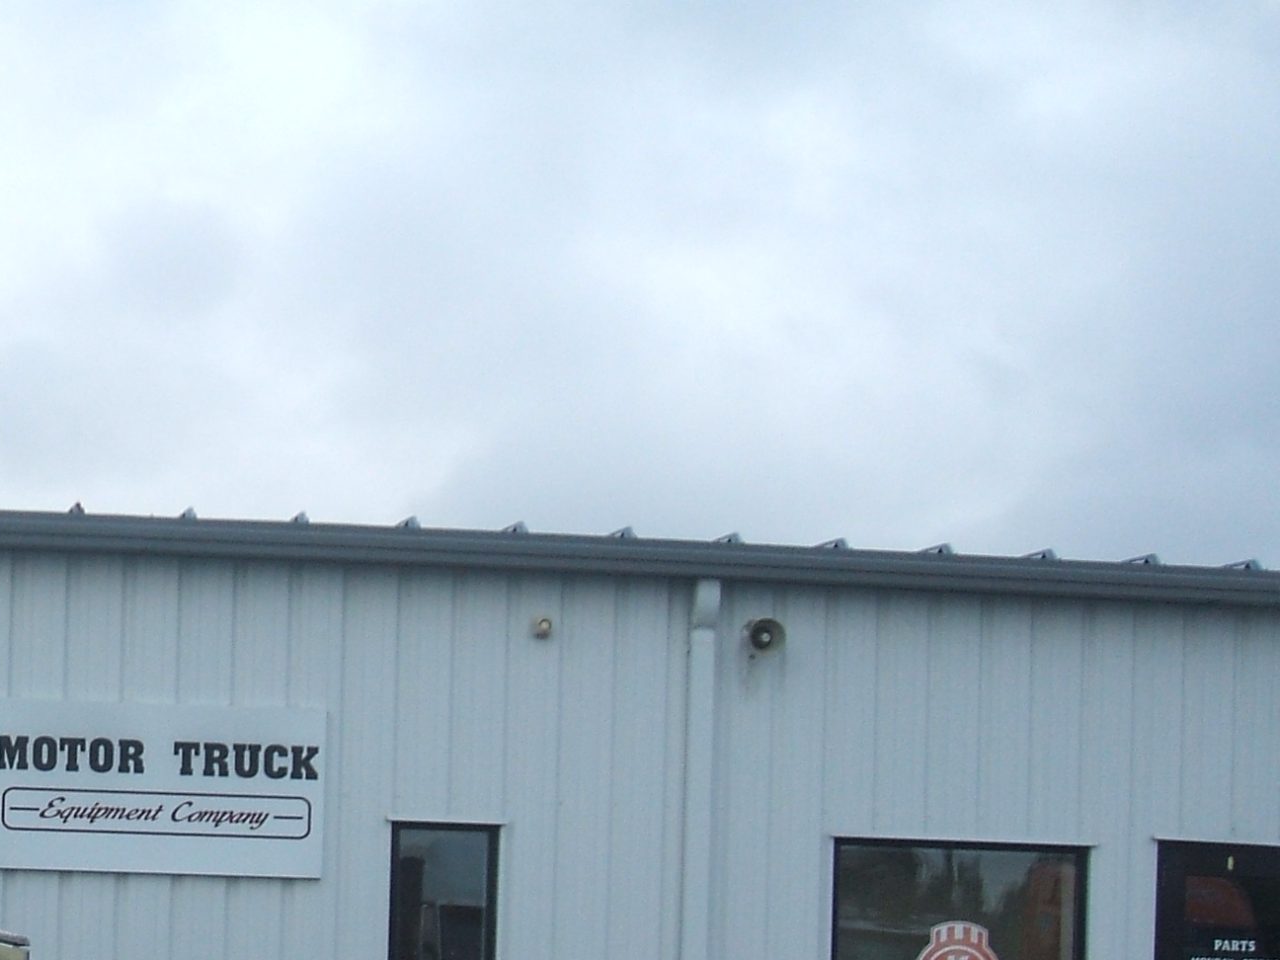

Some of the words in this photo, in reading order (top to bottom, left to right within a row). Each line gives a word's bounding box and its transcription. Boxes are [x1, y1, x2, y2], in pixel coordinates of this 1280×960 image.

[173, 741, 319, 780] TRUCK
[38, 797, 164, 824] Equipment
[171, 801, 270, 830] Company
[1214, 939, 1256, 952] PARTS
